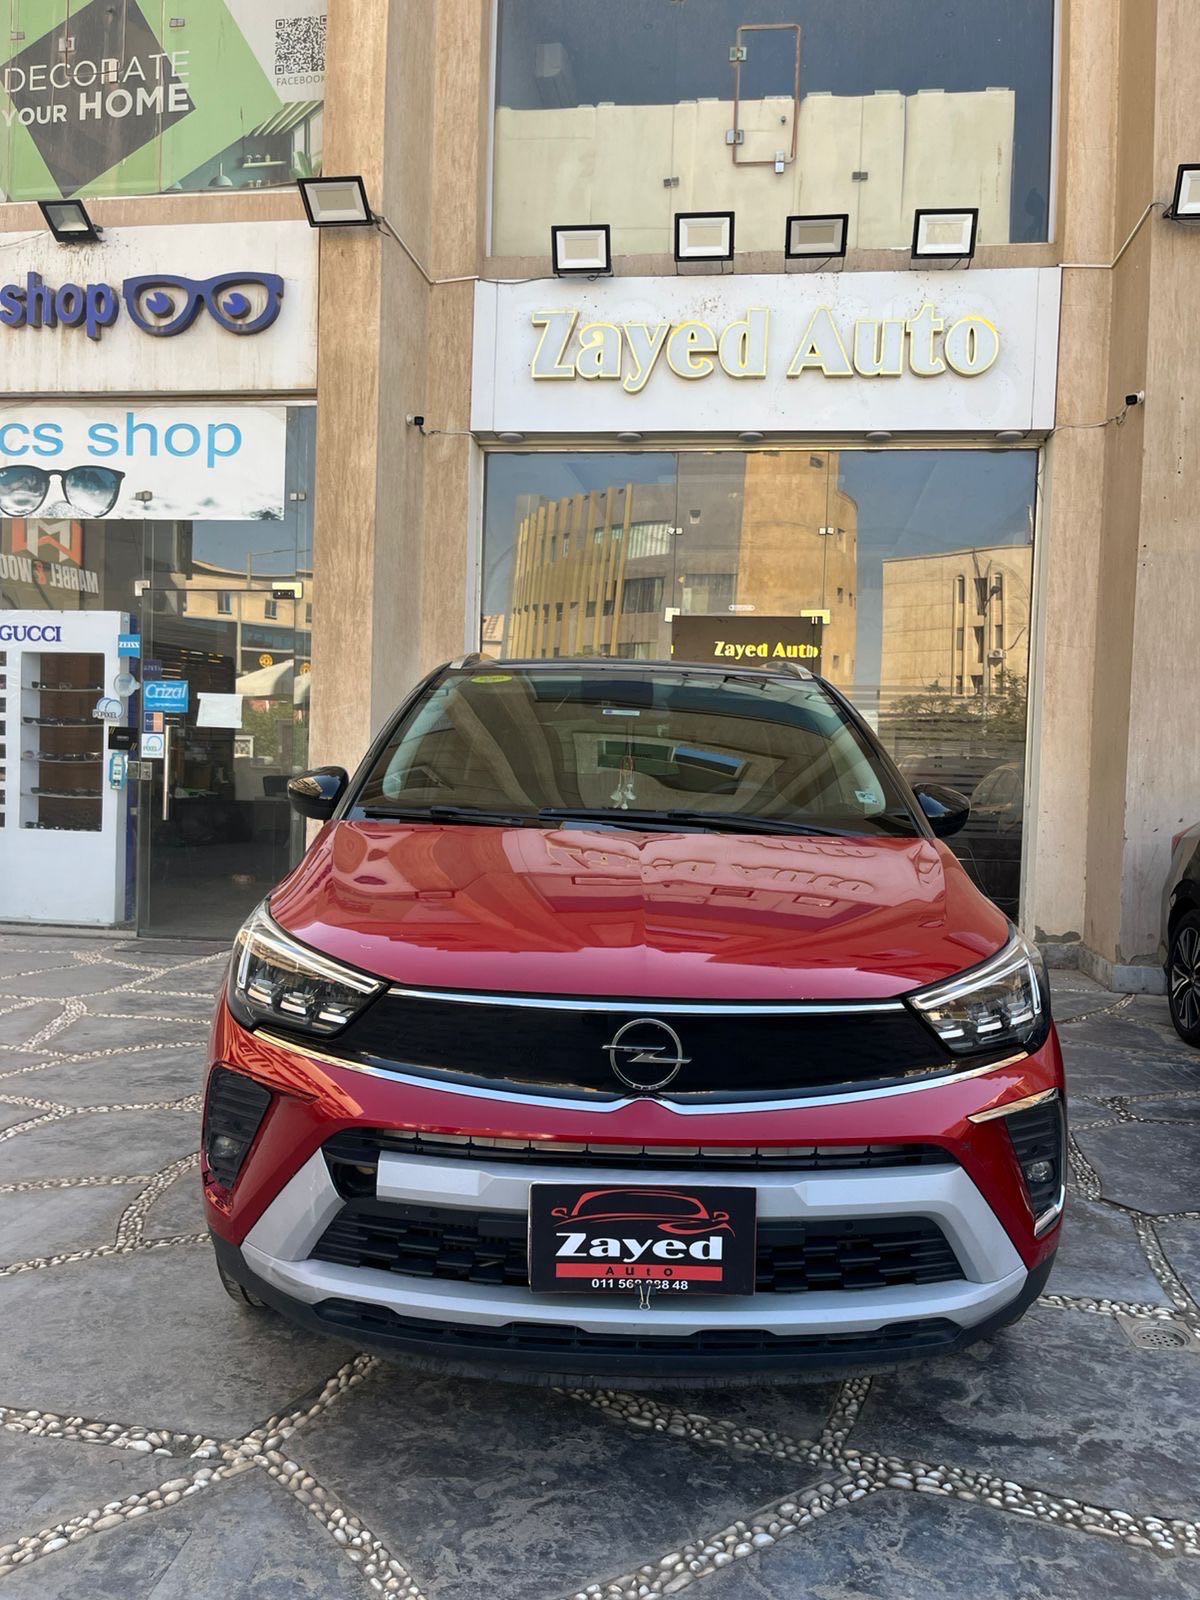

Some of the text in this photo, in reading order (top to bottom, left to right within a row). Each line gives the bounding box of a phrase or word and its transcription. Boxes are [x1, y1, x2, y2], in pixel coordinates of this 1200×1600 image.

[1, 82, 190, 128] YOUR HOME
[0, 271, 120, 341] shop
[531, 303, 1001, 394] Zayed Auto
[87, 412, 243, 468] shop
[0, 624, 62, 643] GUCCI
[714, 641, 818, 660] Zayed Auto
[145, 683, 187, 699] Crizal
[555, 1233, 723, 1263] Zayed
[591, 1278, 614, 1289] 011
[672, 1281, 689, 1291] 48
